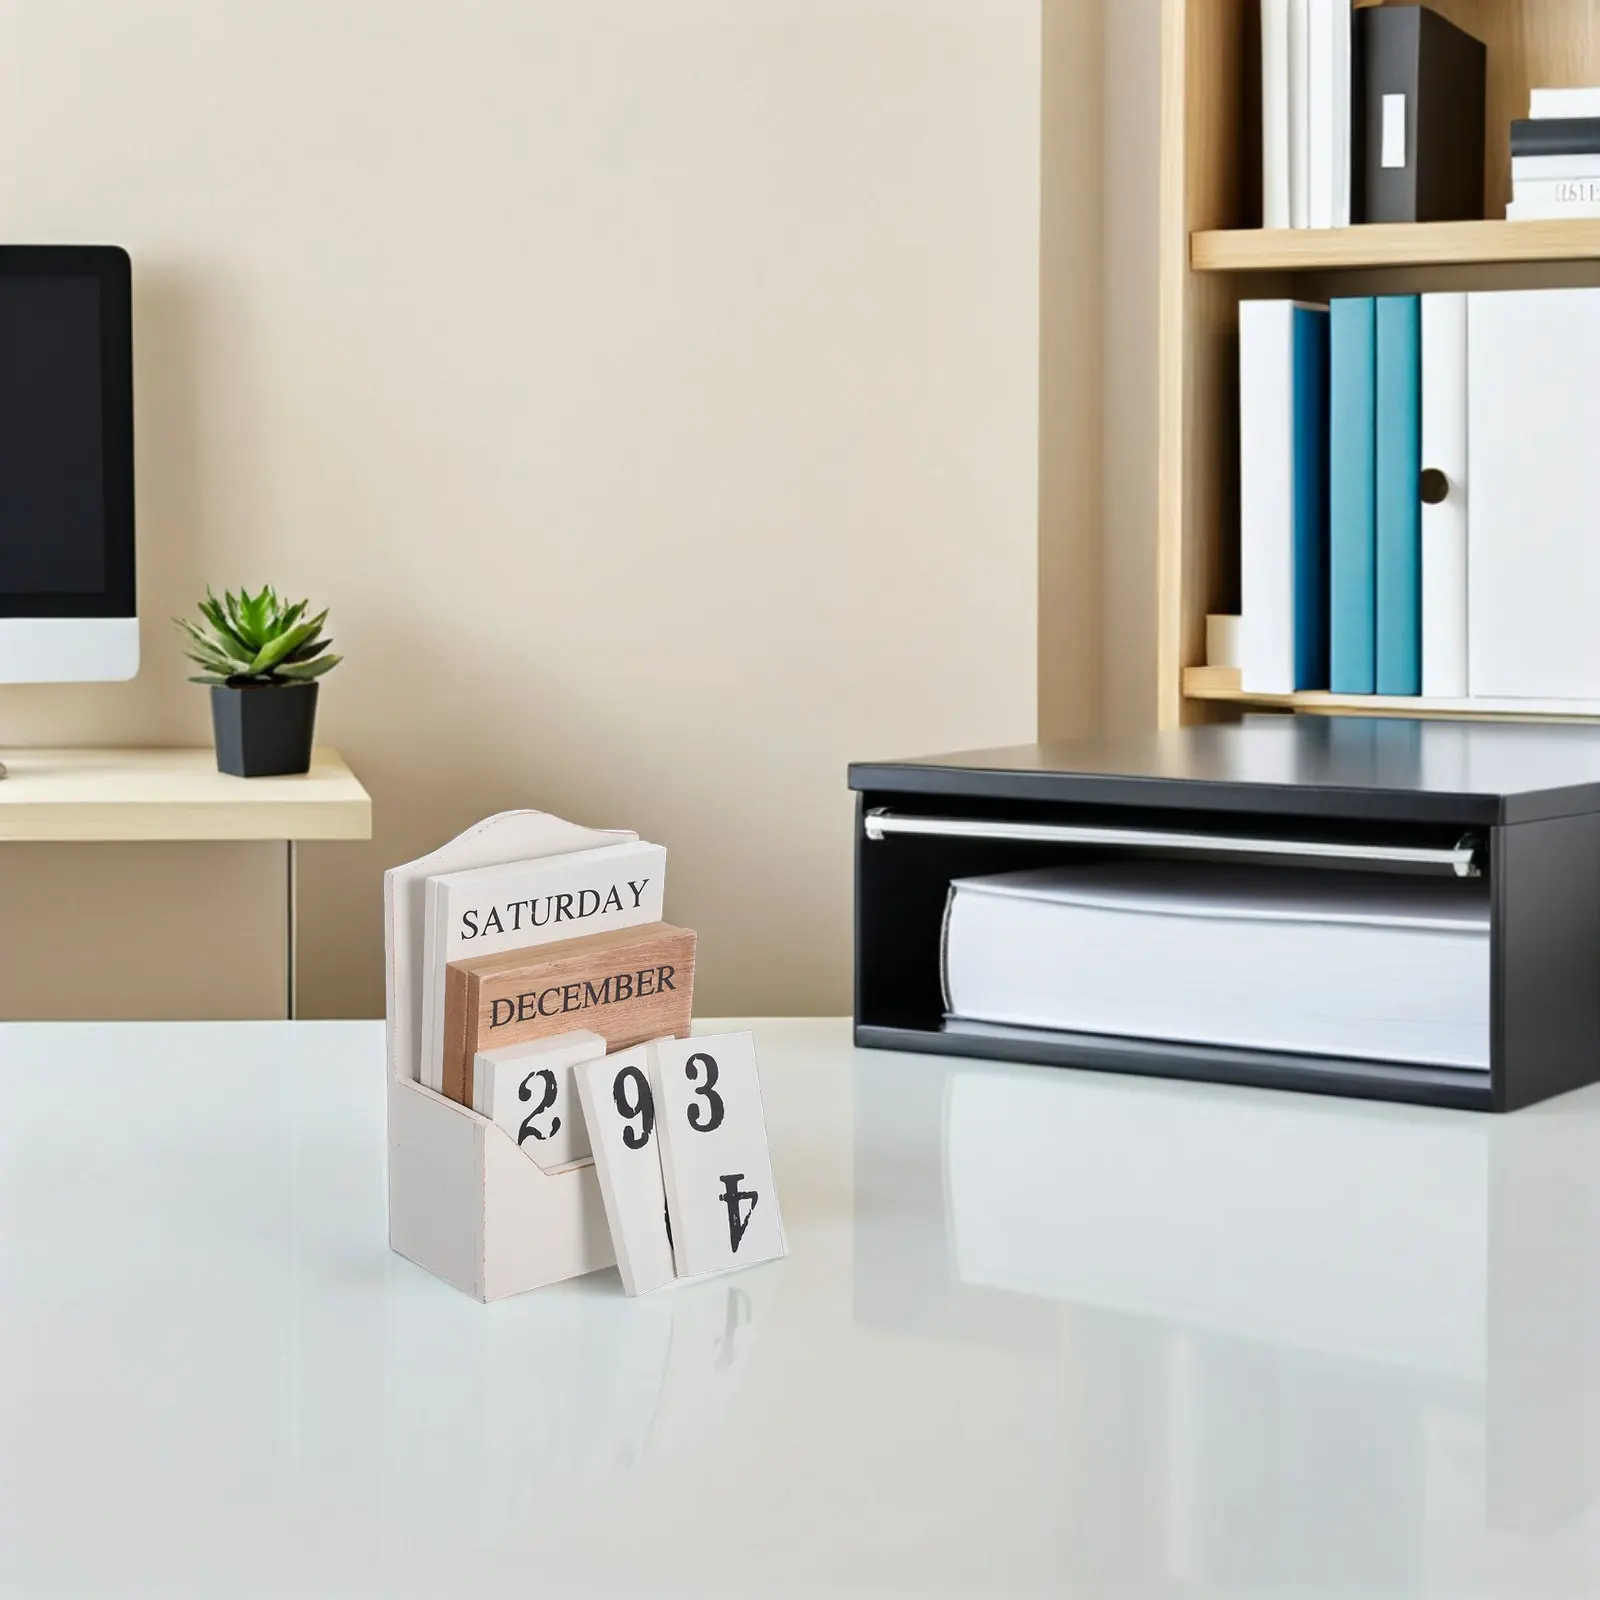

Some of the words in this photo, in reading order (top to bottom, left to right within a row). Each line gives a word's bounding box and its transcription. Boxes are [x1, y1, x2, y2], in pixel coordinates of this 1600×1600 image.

[460, 878, 650, 941] SATURDAY
[489, 964, 677, 1030] DECEMBER
[518, 1068, 562, 1147] 2
[612, 1065, 657, 1150] 9
[685, 1052, 726, 1133] 3
[719, 1173, 759, 1253] 4
